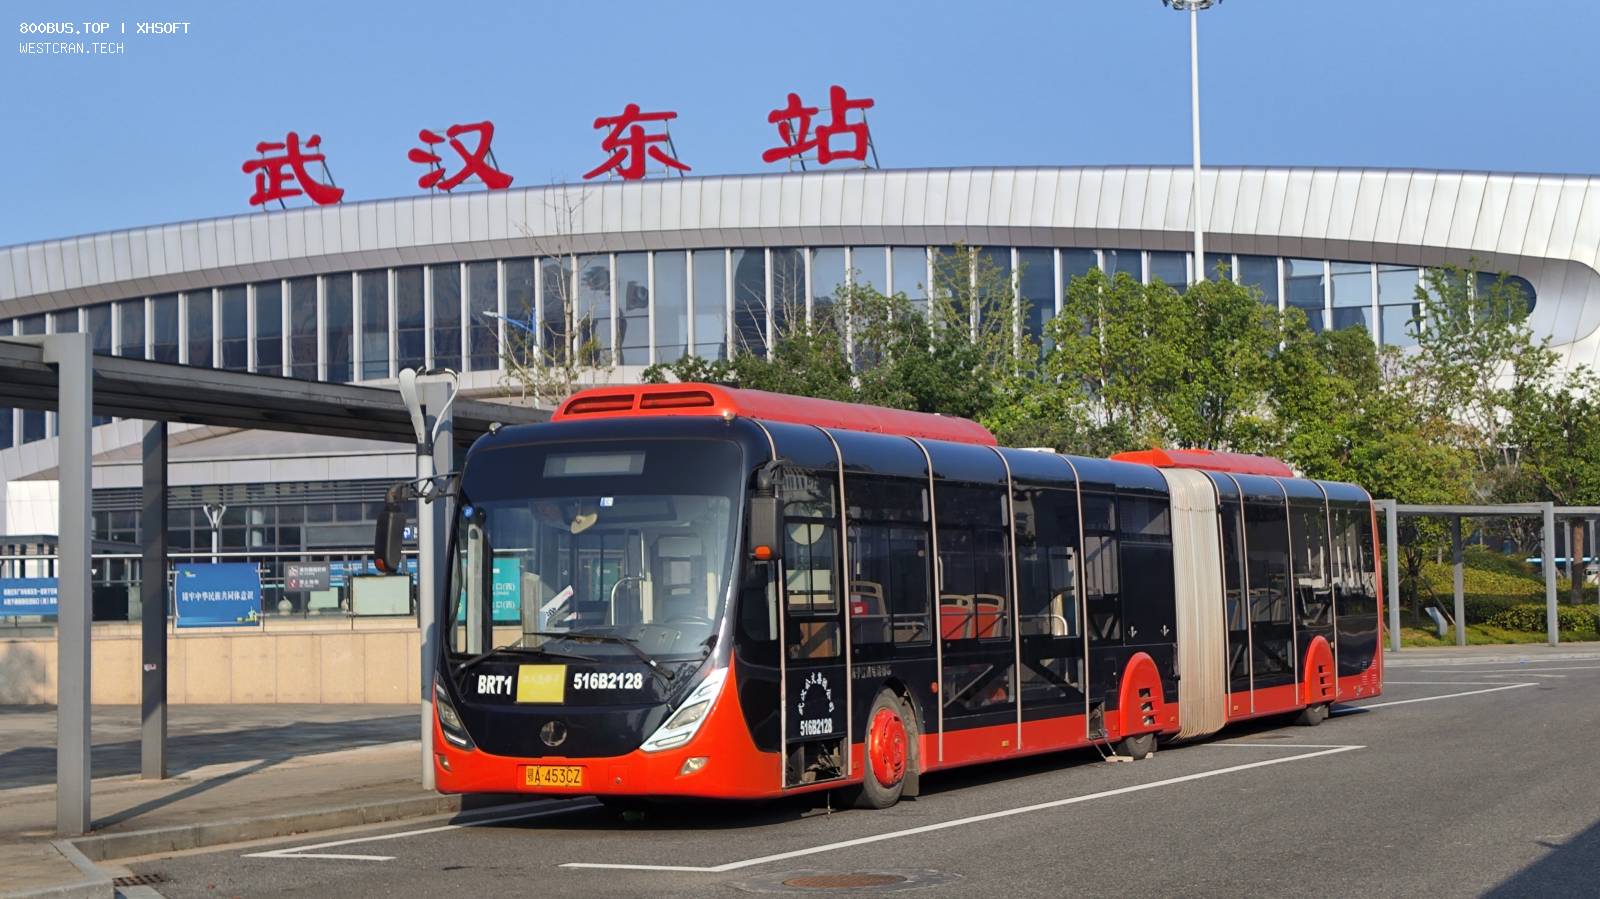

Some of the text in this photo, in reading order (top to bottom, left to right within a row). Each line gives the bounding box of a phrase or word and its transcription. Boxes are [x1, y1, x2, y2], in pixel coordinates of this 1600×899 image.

[242, 85, 874, 205] 武汉东站
[477, 674, 512, 695] BRT1
[573, 672, 643, 690] 516B2128
[800, 718, 833, 736] 516B2128
